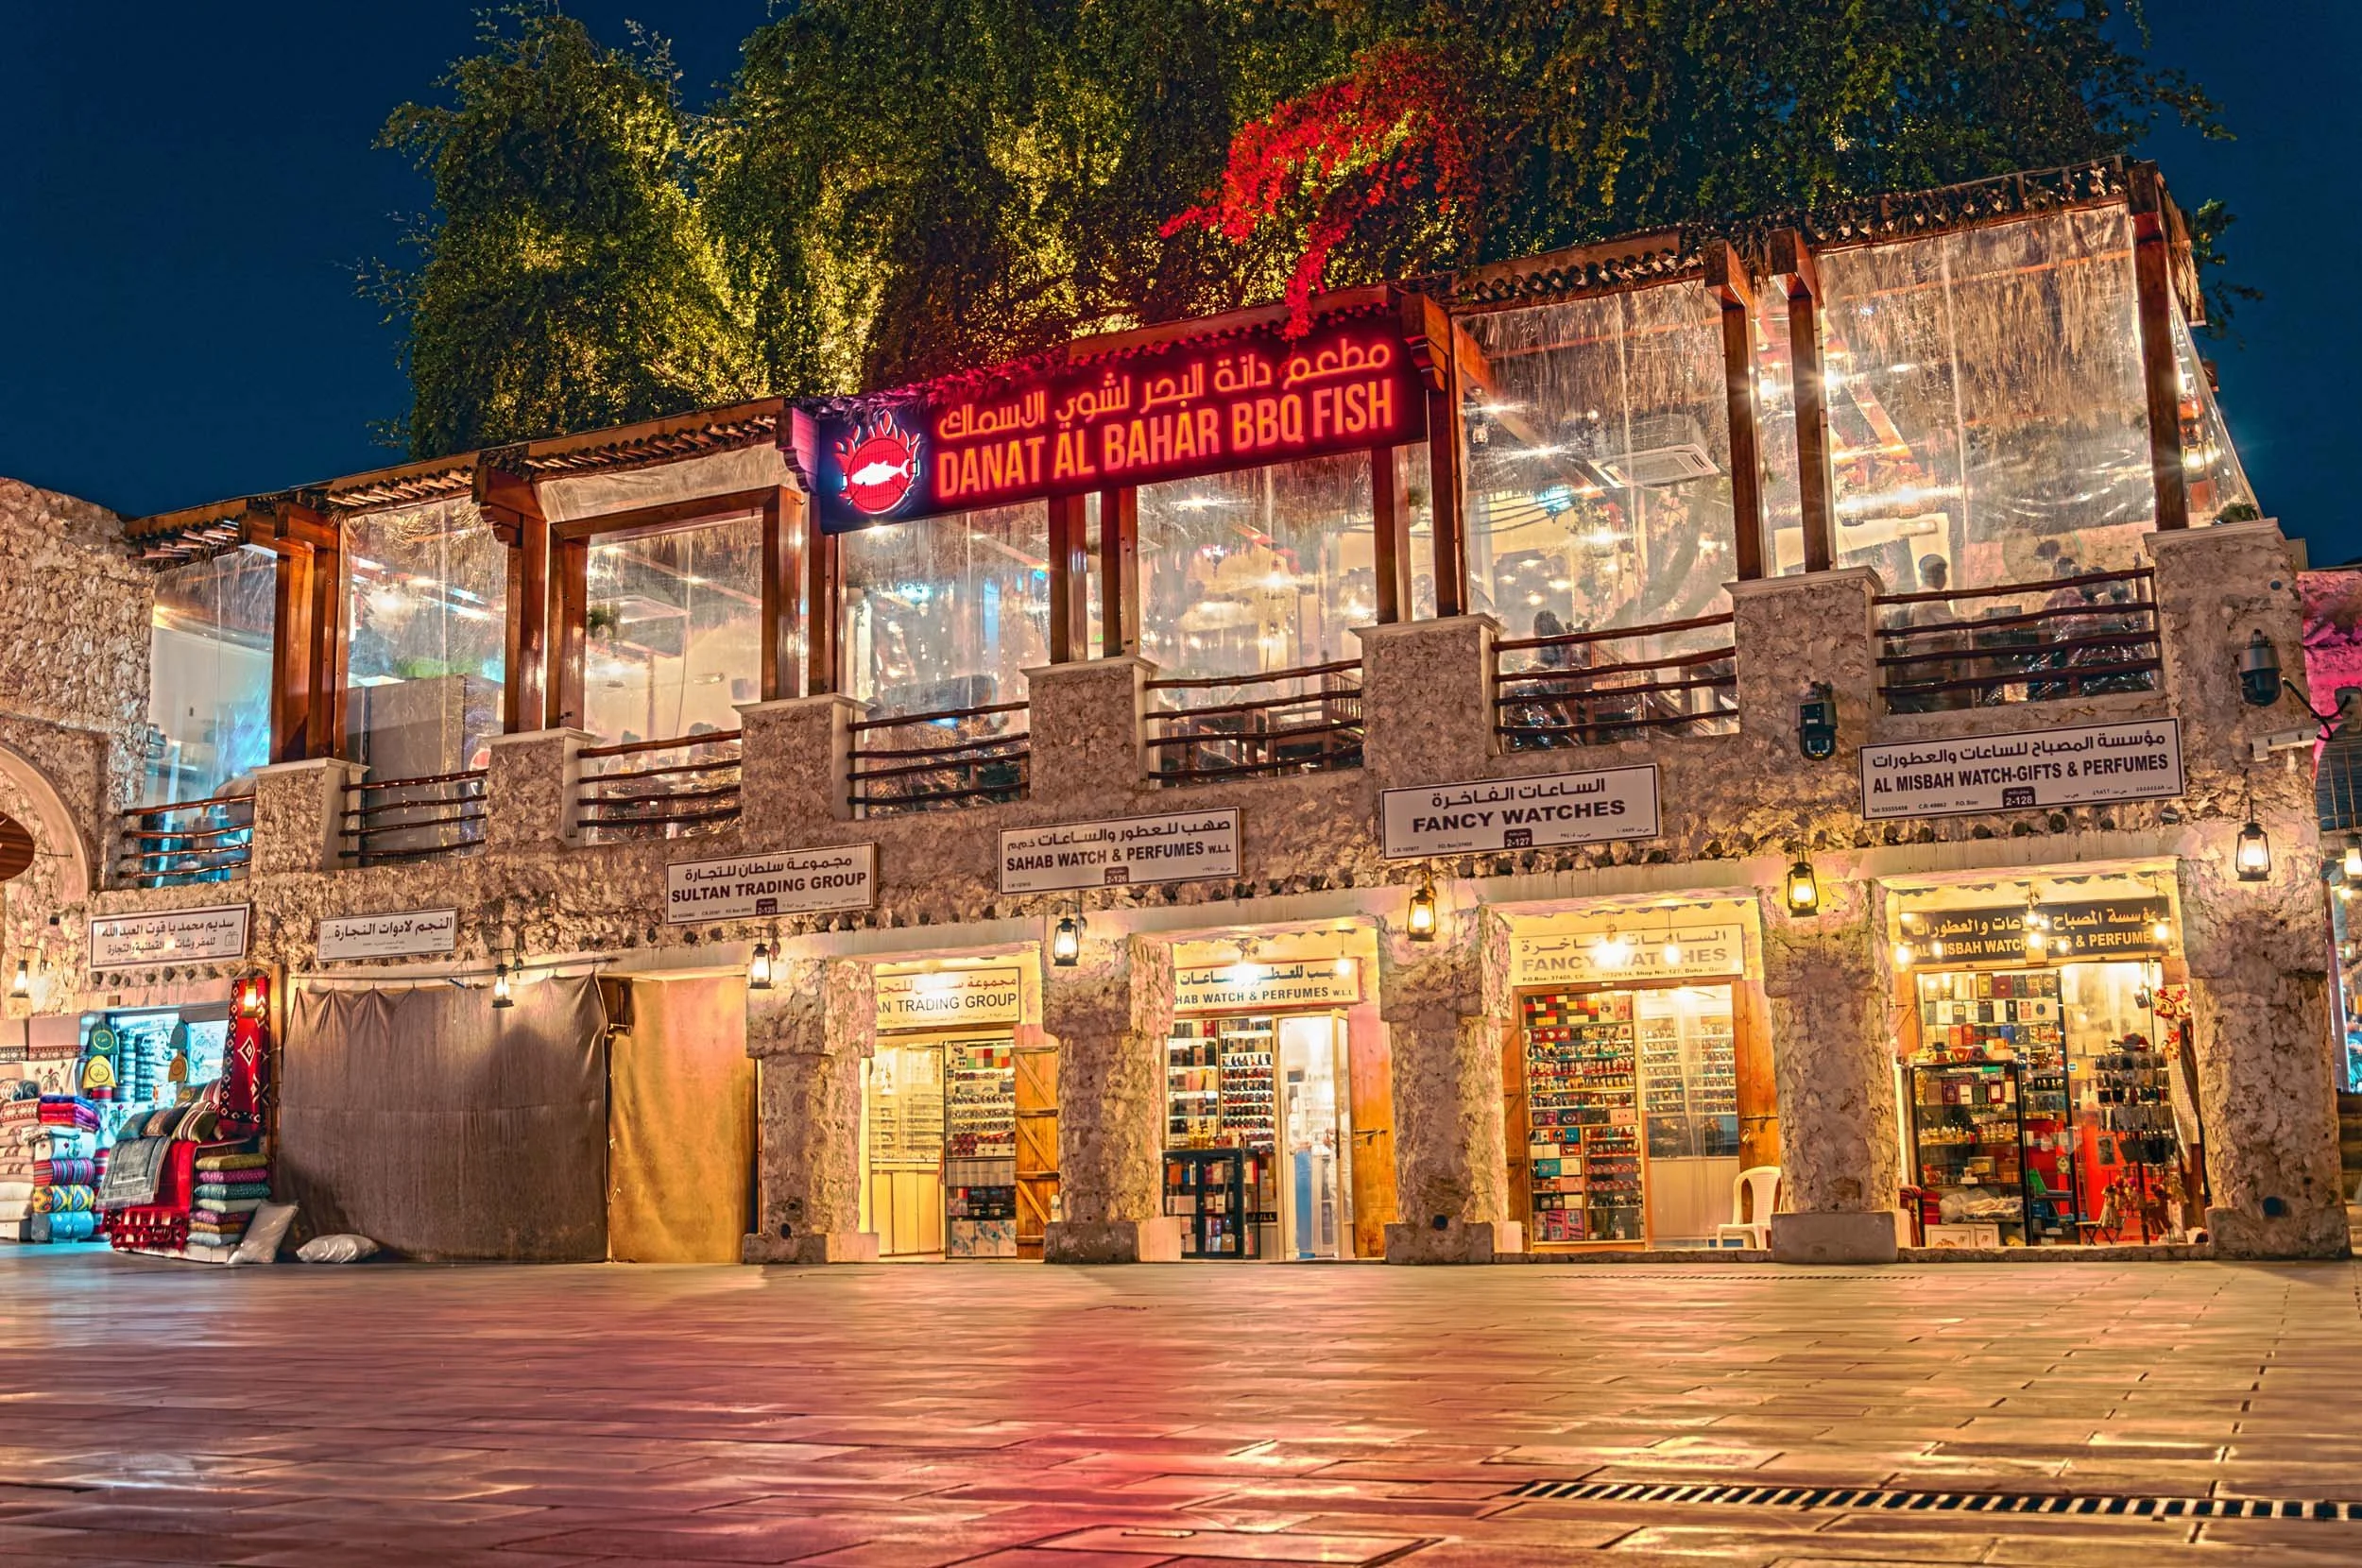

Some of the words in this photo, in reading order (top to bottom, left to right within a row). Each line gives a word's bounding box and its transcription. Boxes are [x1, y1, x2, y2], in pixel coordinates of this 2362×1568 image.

[1214, 352, 1273, 392] دانة
[1282, 337, 1392, 391] مطعم
[1139, 362, 1205, 414] البحر
[1054, 372, 1130, 430] لشوي
[938, 435, 1046, 499] DANAT
[1053, 429, 1096, 480] AL
[1104, 408, 1220, 471] BAHAR
[1231, 393, 1305, 452] BBQ
[1311, 379, 1393, 438] FISH
[2031, 737, 2095, 758] المصباح
[2097, 731, 2165, 748] مؤسسة
[1873, 748, 1957, 770] والعطورات
[1960, 741, 2028, 761] للساعات
[1873, 777, 1892, 794] AL
[1895, 771, 1955, 792] MISBAH
[1959, 762, 2062, 788] WATCH-GIFTS
[2066, 760, 2079, 775] &
[2082, 753, 2168, 776] PERFUMES
[1432, 785, 1515, 810] الفاخرة
[1519, 777, 1606, 801] الساعات
[2005, 795, 2033, 807] 2-128
[1412, 811, 1494, 833] FANCY
[1502, 799, 1625, 825] WATCHES
[1038, 828, 1115, 846] والساعات
[1119, 822, 1179, 842] للعطور
[1181, 819, 1232, 836] صهب
[1506, 837, 1532, 847] 2-127
[787, 857, 853, 872] مجموعة
[1006, 854, 1053, 872] SAHAB
[1058, 848, 1107, 867] WATCH
[1112, 848, 1121, 862] &
[1126, 842, 1205, 861] PERFUMES
[684, 865, 737, 883] للتجارة
[738, 861, 784, 878] سلطان
[1105, 874, 1128, 884] 2-126
[672, 884, 730, 904] SULTAN
[735, 878, 805, 897] TRADING
[811, 872, 866, 891] GROUP
[756, 904, 777, 914] 2-125
[415, 916, 454, 935] النجم
[2052, 910, 2103, 930] المصباح
[334, 922, 376, 941] النجارة
[1933, 940, 1982, 956] ISBAH
[2075, 934, 2085, 948] &
[2089, 930, 2158, 947] PERFUME
[1621, 947, 1728, 967] ATHES
[967, 976, 1018, 991] مجموعة
[897, 997, 960, 1014] TRADING
[965, 992, 1018, 1009] GROUP
[1174, 994, 1199, 1005] HAB
[1202, 991, 1244, 1004] WATCH
[1249, 990, 1258, 1001] &
[1262, 986, 1328, 1000] PERFUMES
